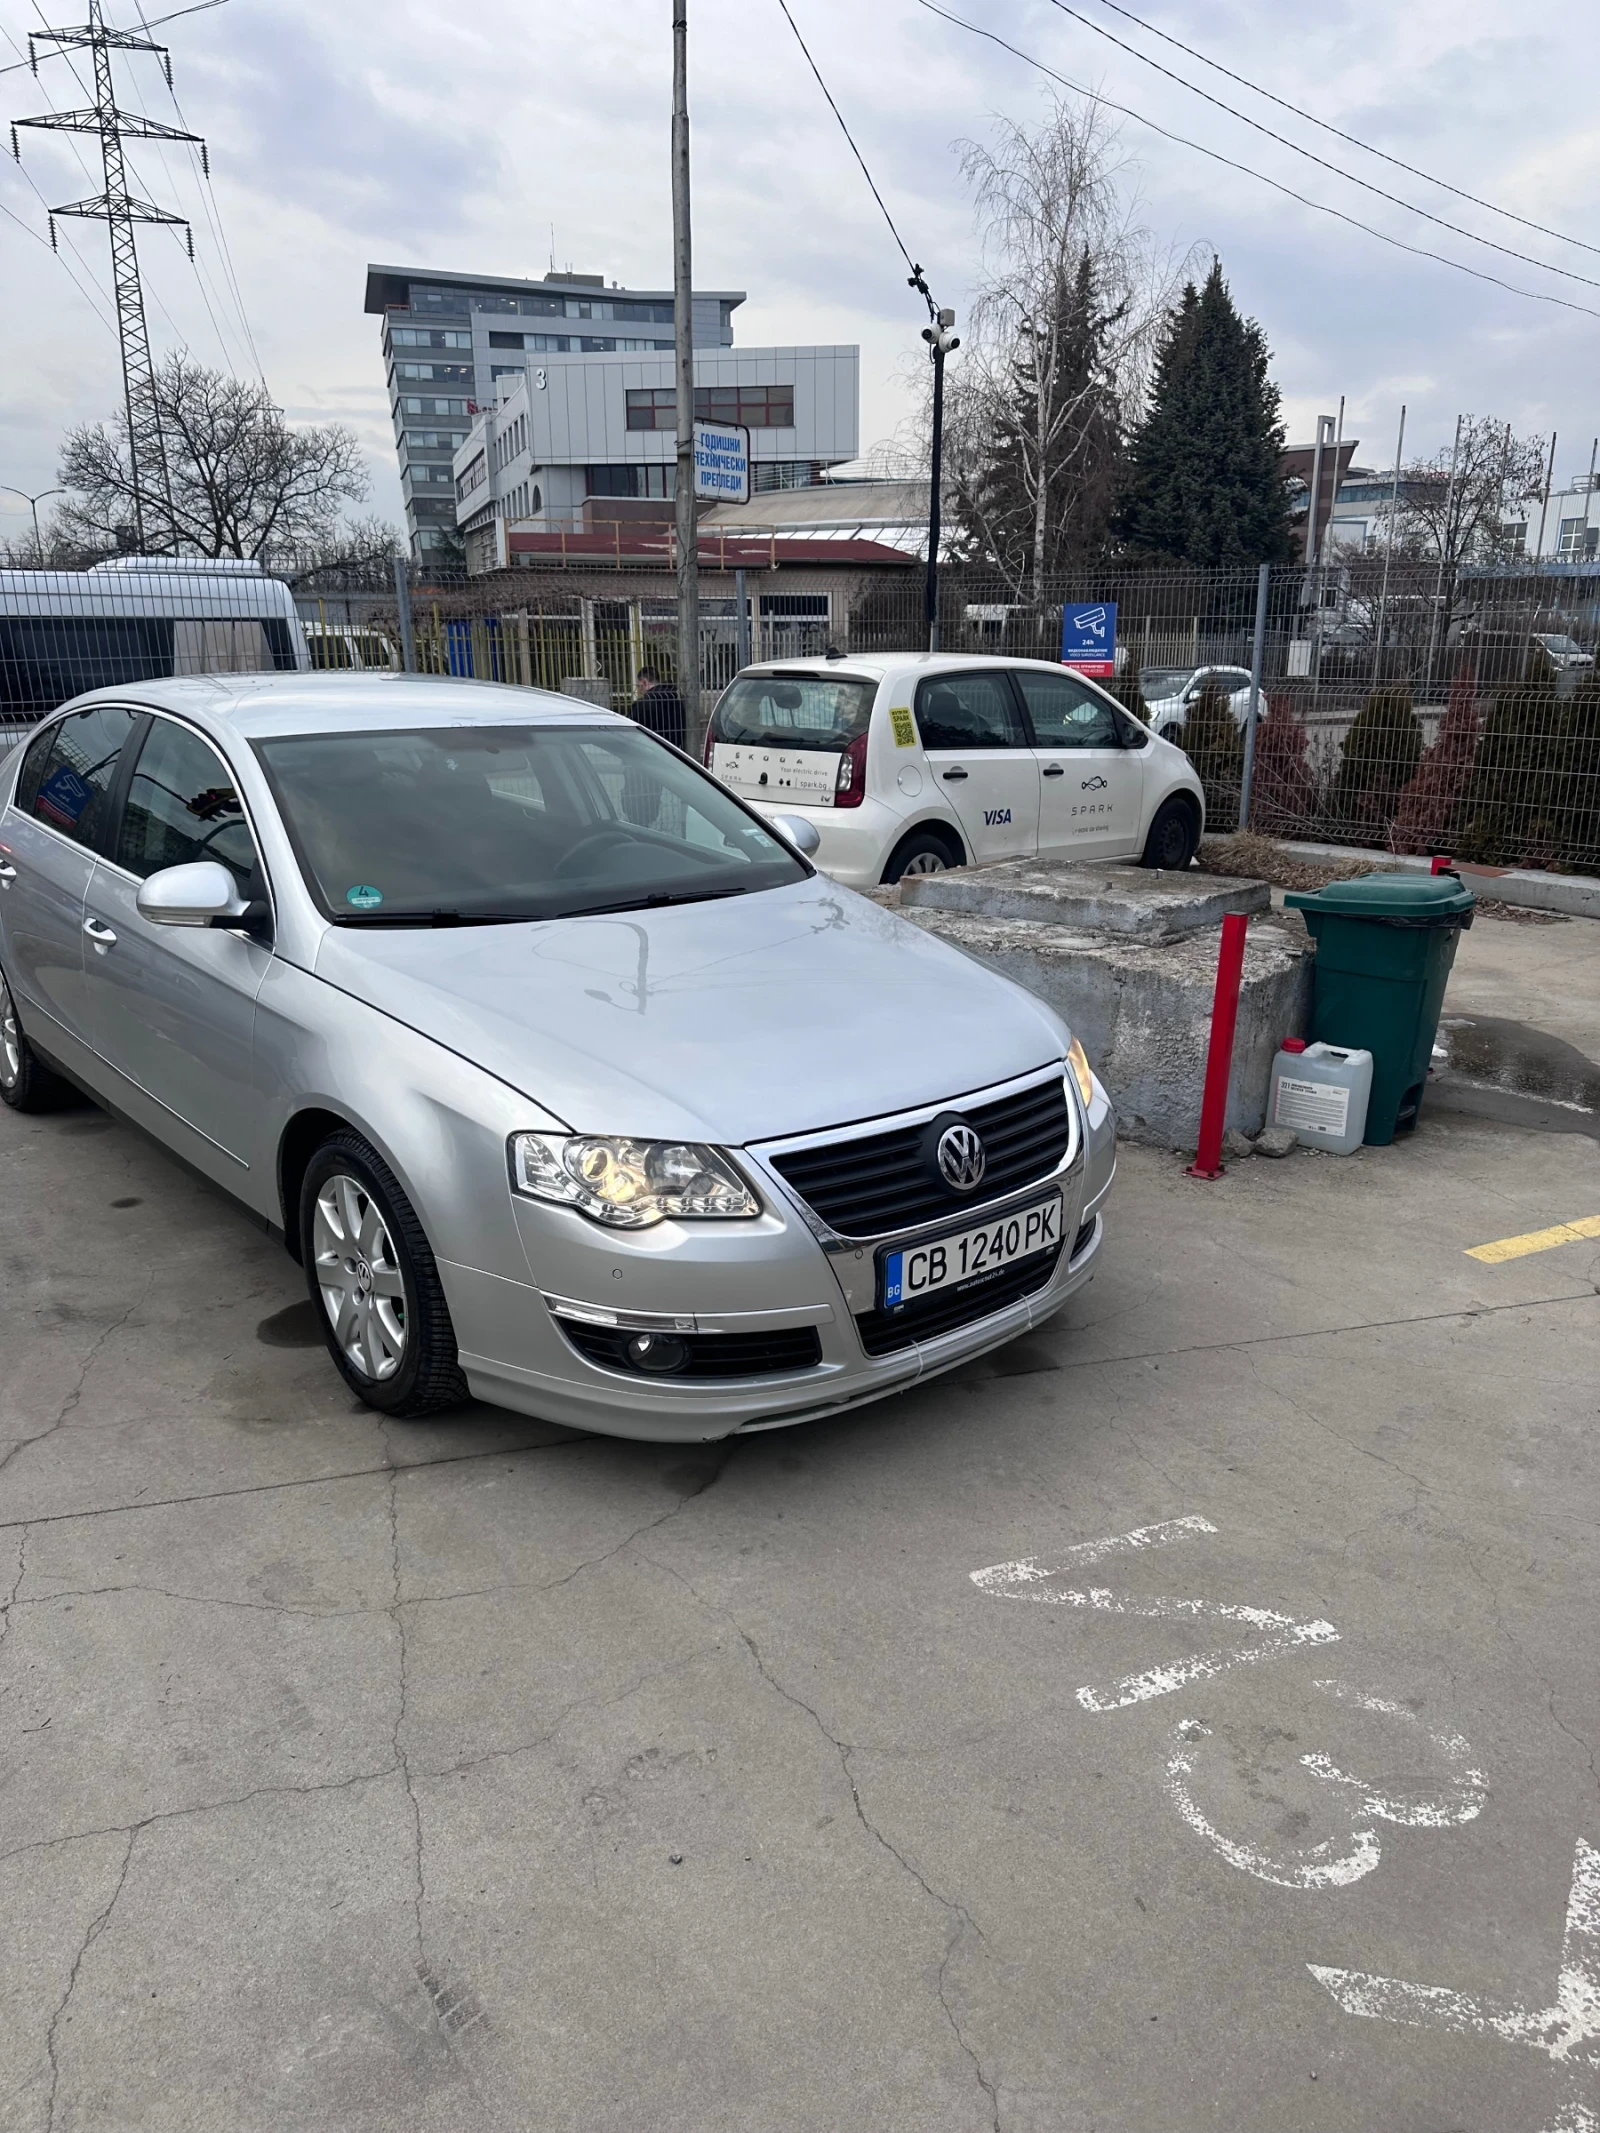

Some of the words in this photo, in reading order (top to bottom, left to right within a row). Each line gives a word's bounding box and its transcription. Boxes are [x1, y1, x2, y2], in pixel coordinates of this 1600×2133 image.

[536, 367, 547, 391] 3
[700, 432, 741, 453] ГОДИШНИ
[695, 450, 746, 473] ТЕХНИЧЕСКИ
[701, 470, 742, 491] ПРЕГЛЕДИ
[793, 767, 813, 775] electric
[800, 781, 827, 790] spark.bg
[983, 808, 1012, 826] VISA
[1070, 803, 1114, 817] SPARK
[358, 885, 369, 897] 4
[908, 1246, 947, 1291] CB
[958, 1219, 1020, 1274] 1240
[1025, 1203, 1057, 1250] PK
[887, 1284, 901, 1299] BG
